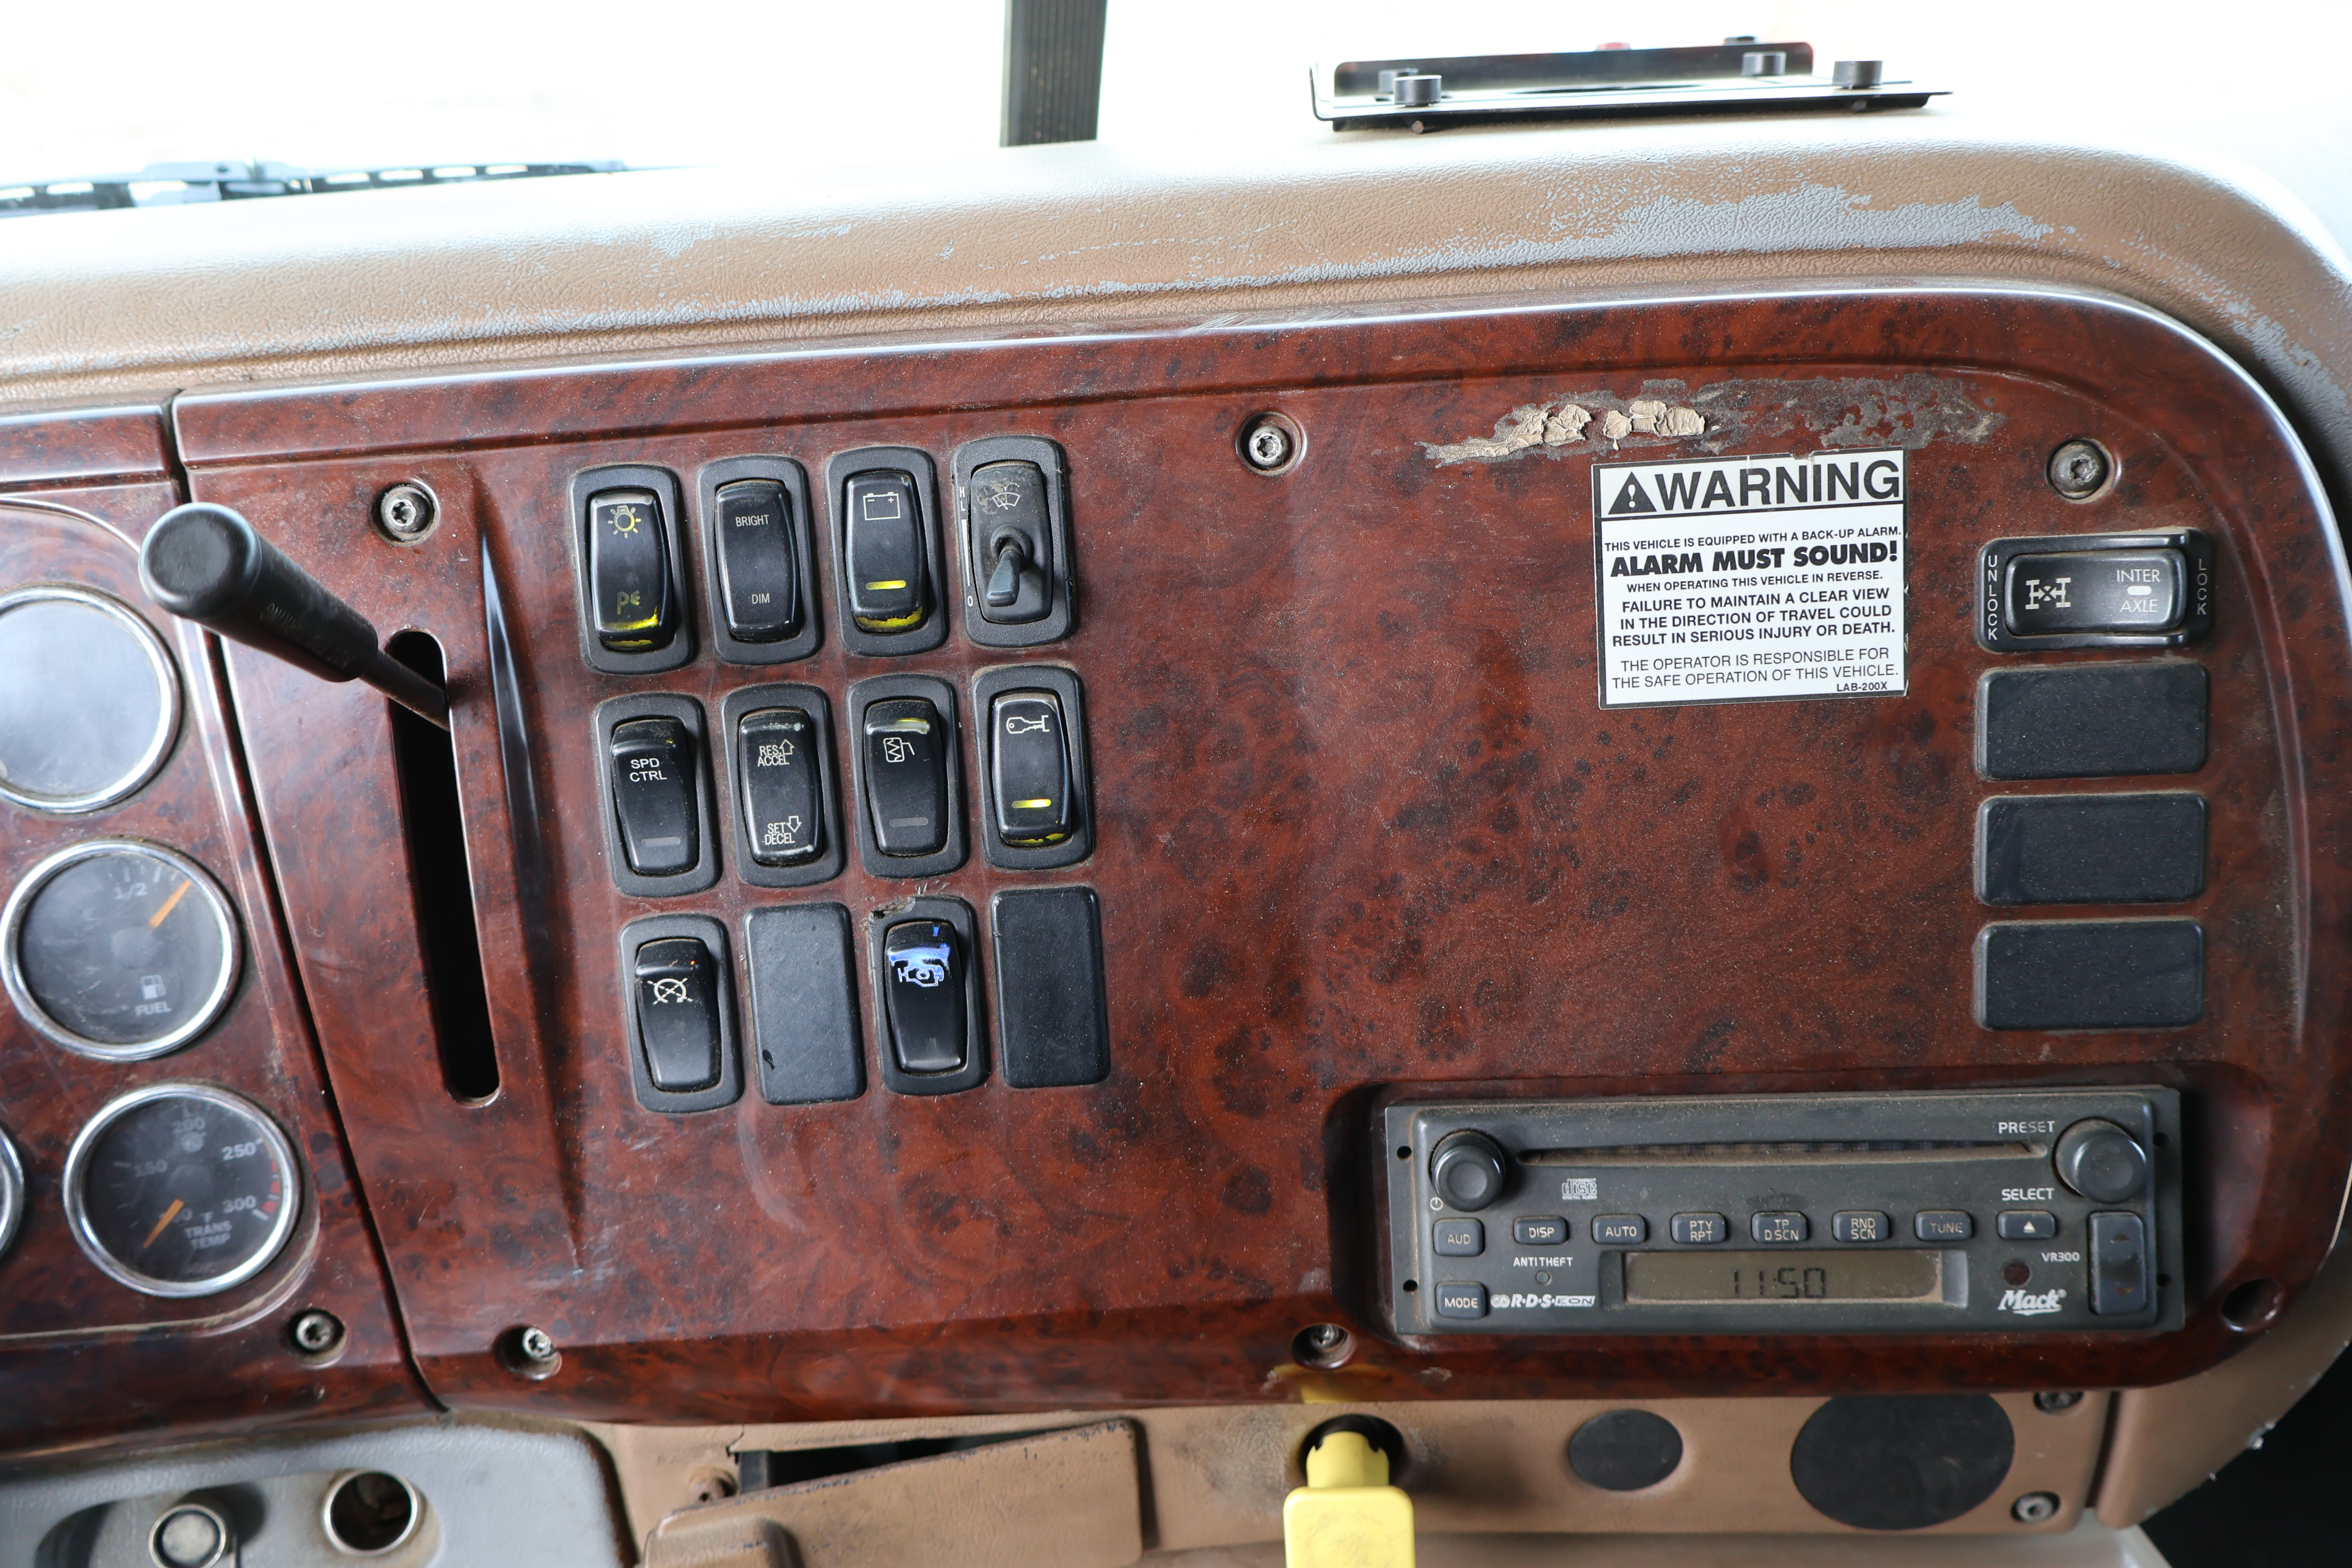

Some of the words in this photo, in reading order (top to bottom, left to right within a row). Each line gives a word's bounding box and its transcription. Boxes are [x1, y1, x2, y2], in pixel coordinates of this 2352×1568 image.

[1655, 460, 1899, 510] WARNING
[735, 514, 769, 526] BRIGHT
[1605, 542, 1630, 551] THIS
[1633, 539, 1680, 550] VEHICLE
[1684, 538, 1694, 546] IS
[1699, 535, 1755, 546] EQUIPPED
[1759, 533, 1787, 542] WITH
[1791, 532, 1798, 541] A
[1802, 529, 1854, 540] BACK-UP
[1858, 526, 1900, 537] ALARM.
[1611, 553, 1703, 577] ALARM
[1713, 548, 1786, 572] MUST
[1794, 541, 1897, 567] SOUND!
[1627, 583, 1660, 592] WHEN
[1664, 579, 1728, 590] OPERATING
[1732, 577, 1757, 586] THIS
[1761, 575, 1808, 585] VEHICLE
[1813, 574, 1823, 582] IN
[1828, 571, 1882, 581] REVERSE.
[2117, 569, 2160, 583] INTER
[2197, 559, 2208, 615] LOCK
[752, 593, 770, 604] DIM
[1623, 599, 1682, 612] FAILURE
[1686, 598, 1705, 609] TO
[1711, 594, 1780, 608] MAINTAIN
[1785, 593, 1795, 604] A
[1800, 590, 1847, 603] CLEAR
[1853, 588, 1889, 600] VIEW
[1987, 555, 1998, 640] UNLOCK
[2120, 600, 2158, 612] AXLE
[1621, 619, 1634, 630] IN
[1639, 617, 1667, 628] THE
[1673, 613, 1750, 627] DIRECTION
[1756, 611, 1775, 622] OF
[1780, 608, 1835, 621] TRAVEL
[1840, 605, 1891, 618] COULD
[1613, 633, 1666, 646] RESULT
[1672, 633, 1685, 643] IN
[1691, 629, 1754, 642] SERIOUS
[1760, 626, 1811, 639] INJURY
[1817, 625, 1837, 636] OR
[1843, 622, 1894, 635] DEATH.
[1621, 660, 1648, 671] THE
[1654, 656, 1730, 670] OPERATOR
[1737, 655, 1748, 666] IS
[1754, 650, 1853, 664] RESPONSIBLE
[1860, 648, 1888, 659] FOR
[1612, 677, 1639, 688] THE
[1645, 675, 1680, 687] SAFE
[1686, 671, 1766, 685] OPERATION
[1773, 669, 1791, 681] OF
[1796, 668, 1828, 679] THIS
[1833, 664, 1897, 677] VEHICLE.
[1837, 682, 1887, 691] LAB-200X
[759, 745, 782, 756] RES.
[630, 758, 659, 769] SPD
[757, 755, 789, 767] ACCEL
[630, 770, 667, 782] CTRL
[768, 822, 786, 834] SET
[765, 833, 795, 845] DECEL
[114, 882, 148, 901] 1/2
[135, 1001, 172, 1017] FUEL
[172, 1117, 206, 1134] 200
[1998, 1120, 2056, 1134] PRESET
[221, 1142, 256, 1161] 250
[134, 1159, 168, 1177] 150
[2001, 1187, 2054, 1201] SELECT
[222, 1195, 257, 1214] 300
[183, 1220, 232, 1239] TRANS
[1690, 1220, 1713, 1231] PTY
[1773, 1219, 1790, 1230] TP
[1851, 1218, 1876, 1229] RND
[1930, 1222, 1964, 1233] TUNE
[1529, 1227, 1555, 1238] DISP
[1606, 1226, 1637, 1237] AUTO
[1690, 1231, 1713, 1241] RPT
[1851, 1229, 1876, 1240] SCN
[191, 1232, 231, 1251] TEMP
[1447, 1234, 1471, 1245] AUD
[2041, 1251, 2081, 1262] VR300
[1445, 1297, 1479, 1308] MODE
